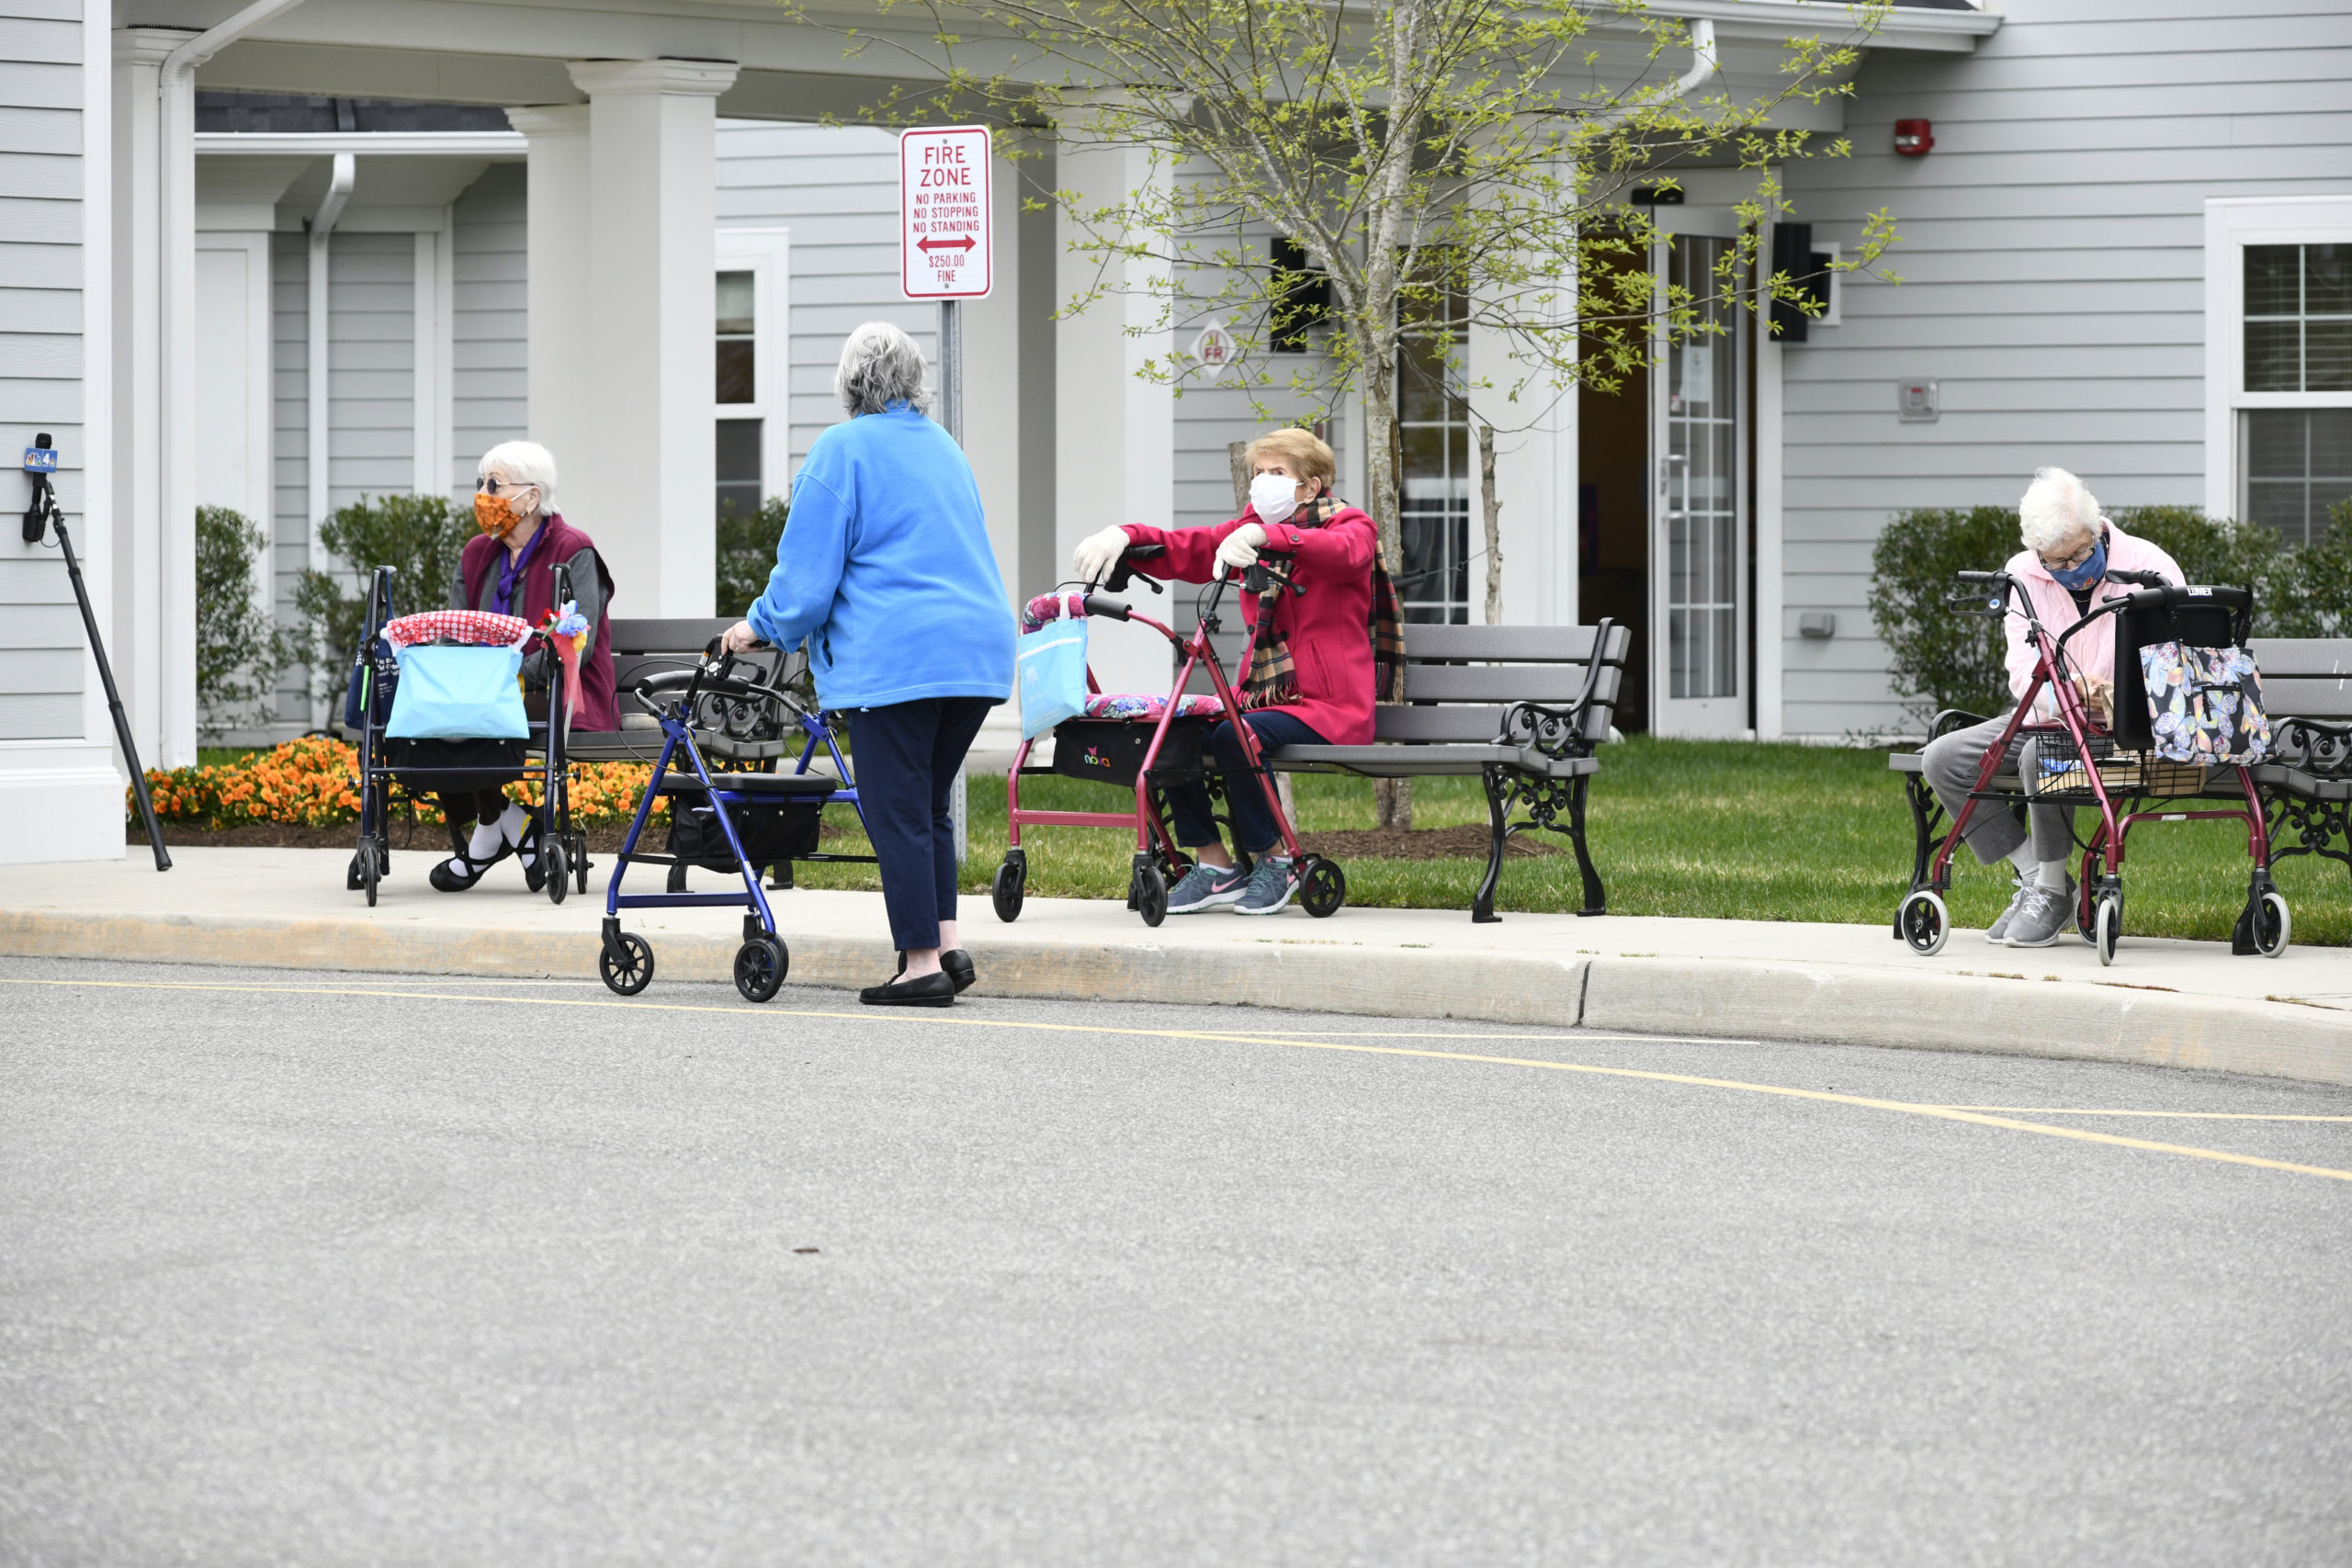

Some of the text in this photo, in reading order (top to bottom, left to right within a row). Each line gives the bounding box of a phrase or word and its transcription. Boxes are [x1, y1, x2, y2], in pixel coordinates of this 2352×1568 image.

[924, 145, 966, 164] FIRE
[920, 167, 971, 187] ZONE
[915, 191, 977, 205] NO PARKING
[913, 206, 978, 220] NO STOPPING
[913, 220, 979, 233] NO STANDING
[928, 254, 966, 268] $250.00
[937, 270, 956, 283] FINE
[42, 453, 50, 465] 4
[1084, 754, 1111, 768] nova
